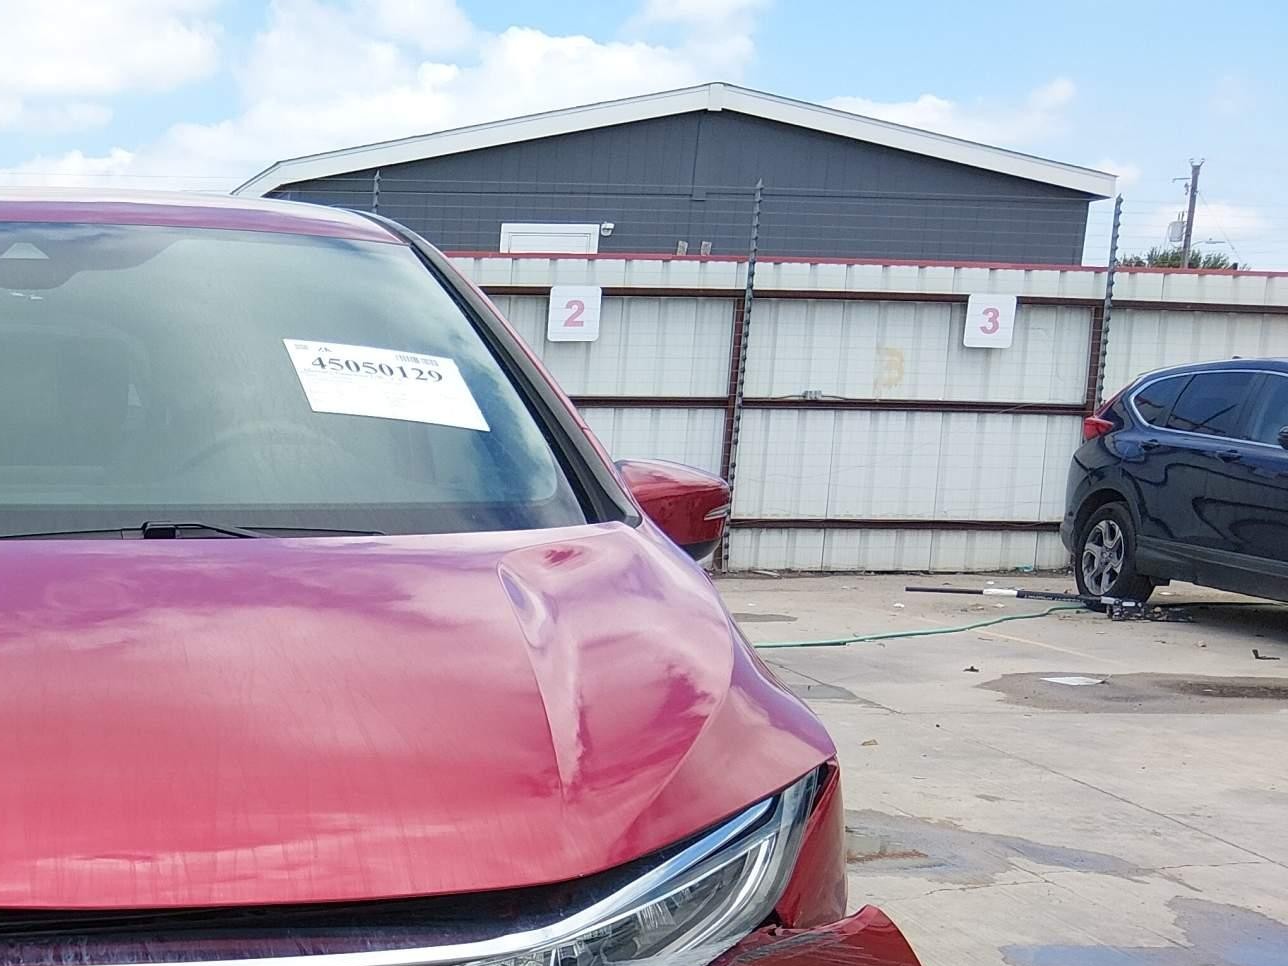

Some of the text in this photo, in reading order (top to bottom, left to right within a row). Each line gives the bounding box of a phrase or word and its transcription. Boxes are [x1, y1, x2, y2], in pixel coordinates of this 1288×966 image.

[563, 300, 585, 327] 2
[981, 307, 1001, 334] 3
[311, 356, 443, 382] 45050129
